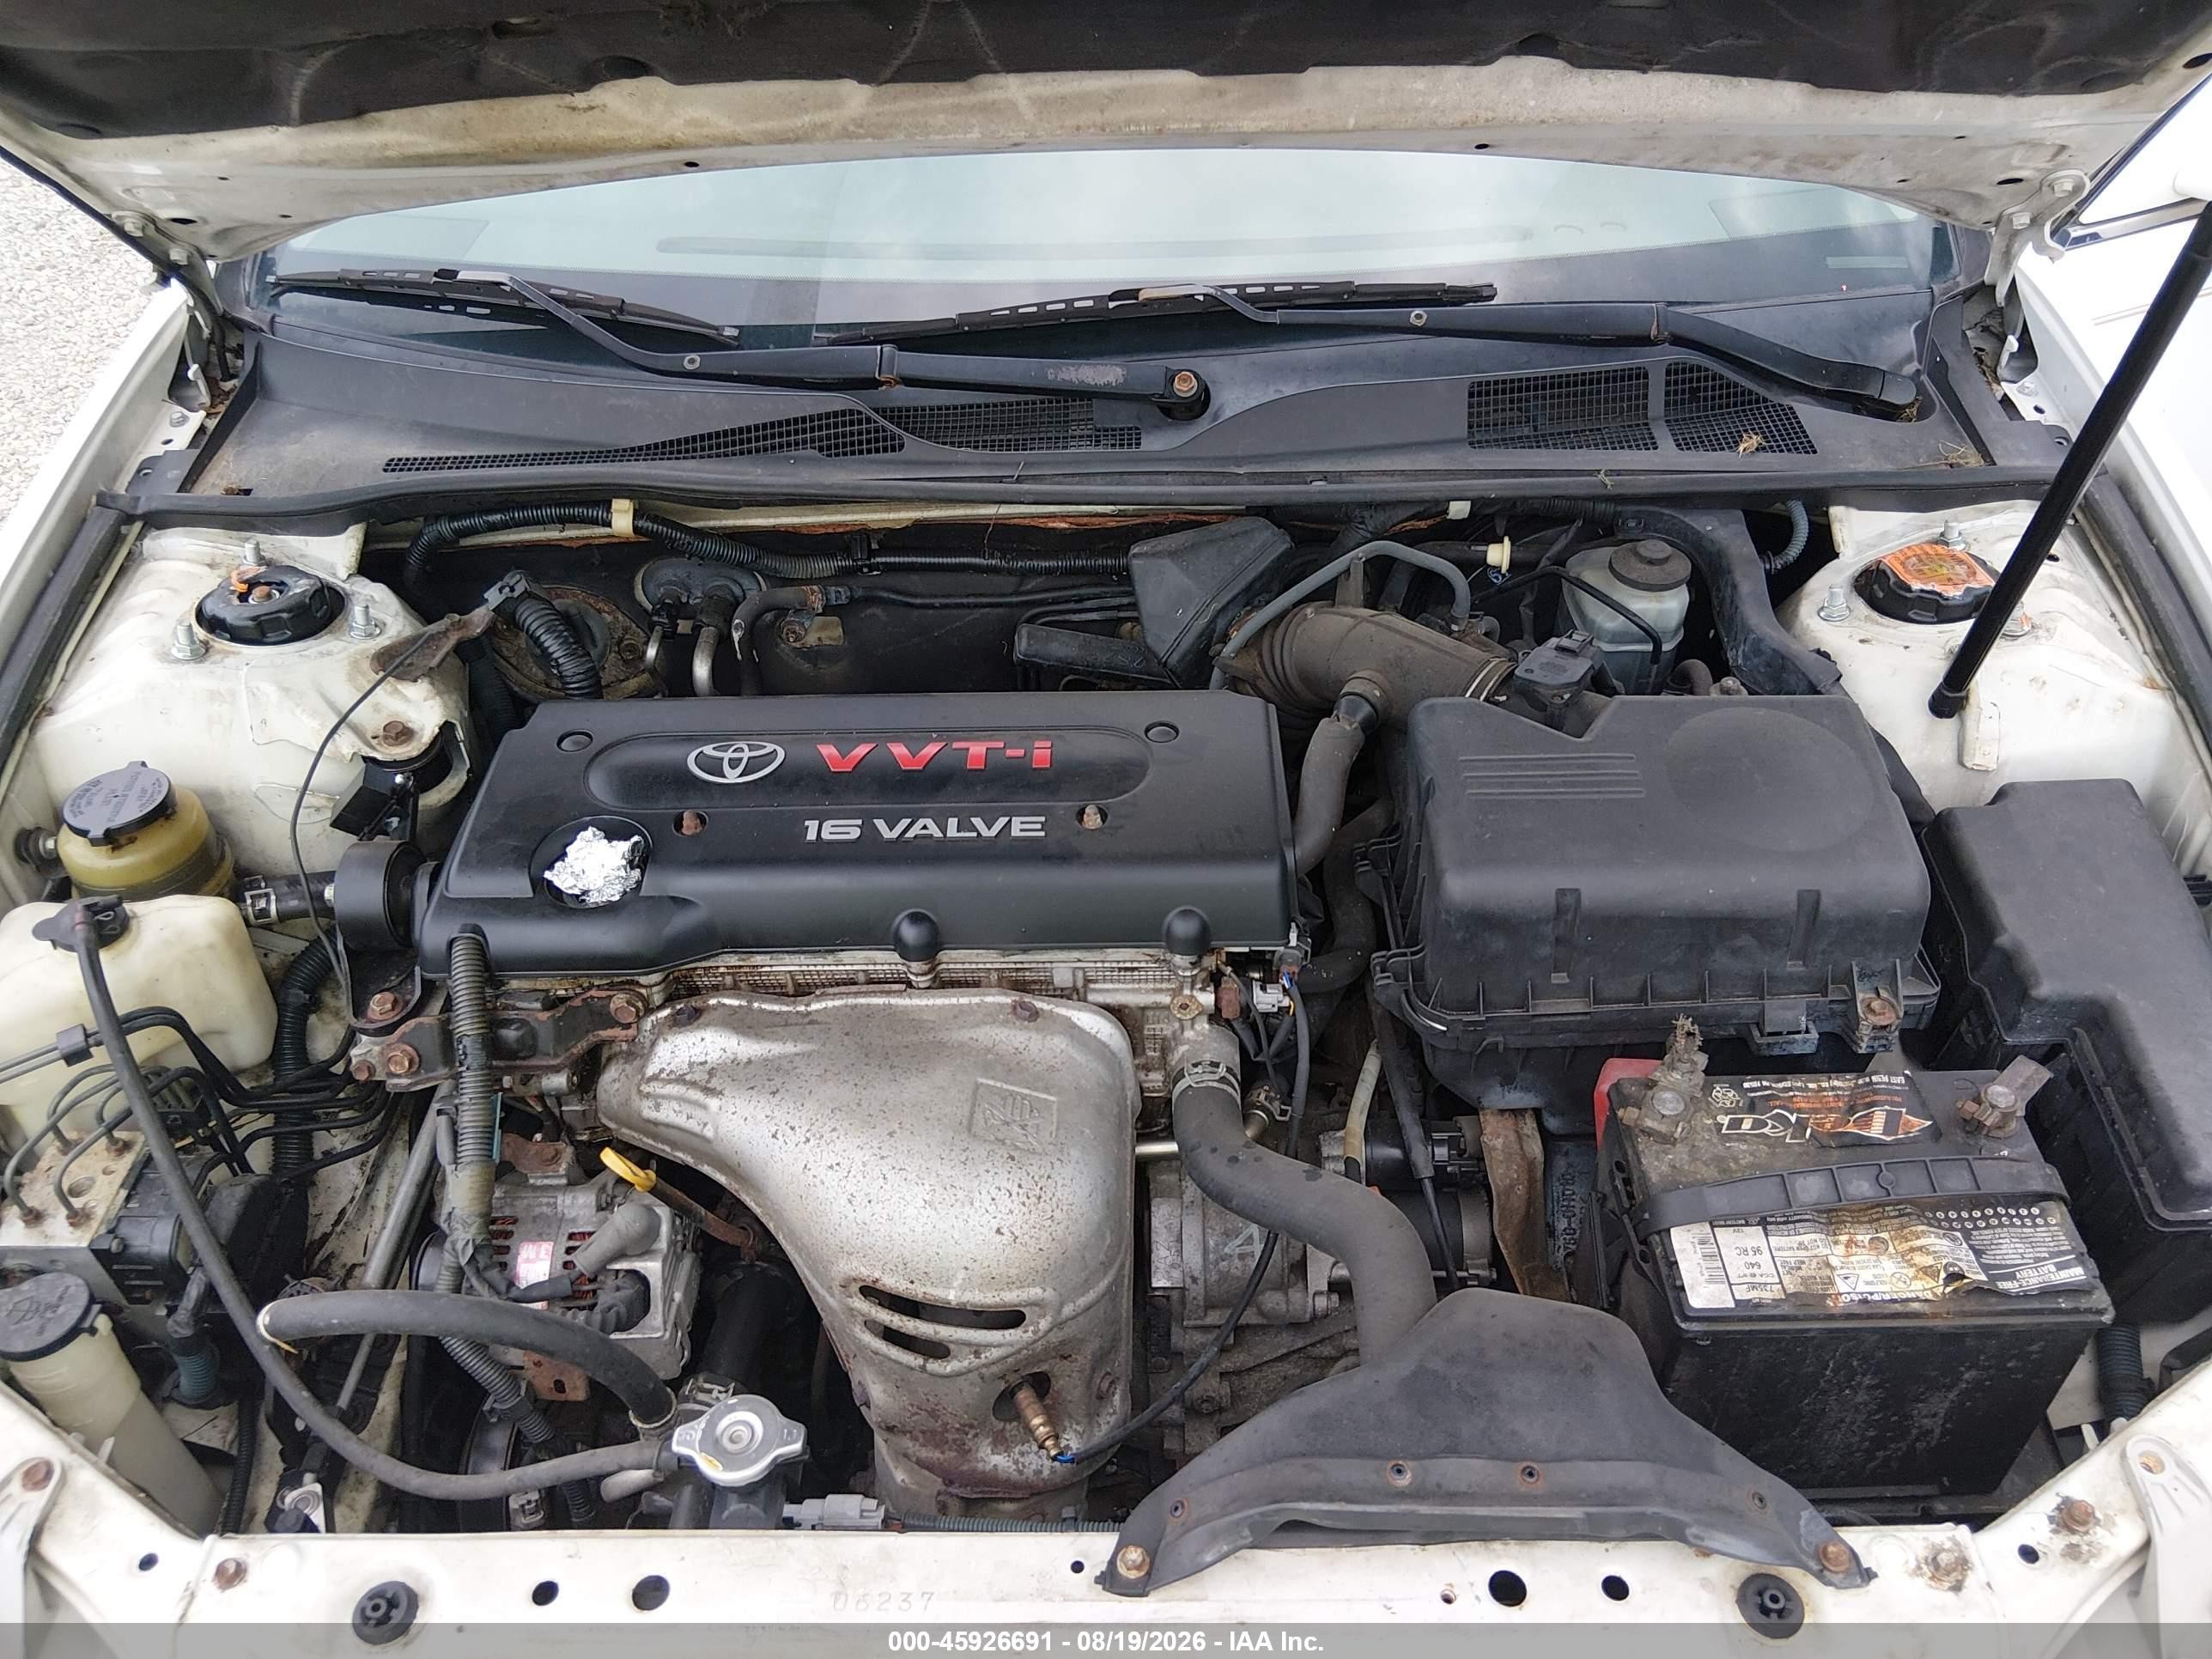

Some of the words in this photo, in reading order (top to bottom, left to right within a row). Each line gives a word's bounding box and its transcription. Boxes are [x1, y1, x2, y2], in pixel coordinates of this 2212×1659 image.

[817, 740, 1053, 772] VVT-i
[804, 817, 862, 842] 16
[873, 815, 1046, 841] VALVE
[1735, 1246, 1749, 1256] RC
[1751, 1245, 1763, 1256] 95
[1744, 1261, 1761, 1270] 640
[2014, 1264, 2057, 1279] BATTERY
[1995, 1266, 2085, 1290] MAINTENANCE-FREE
[1745, 1284, 1774, 1292] 735MF
